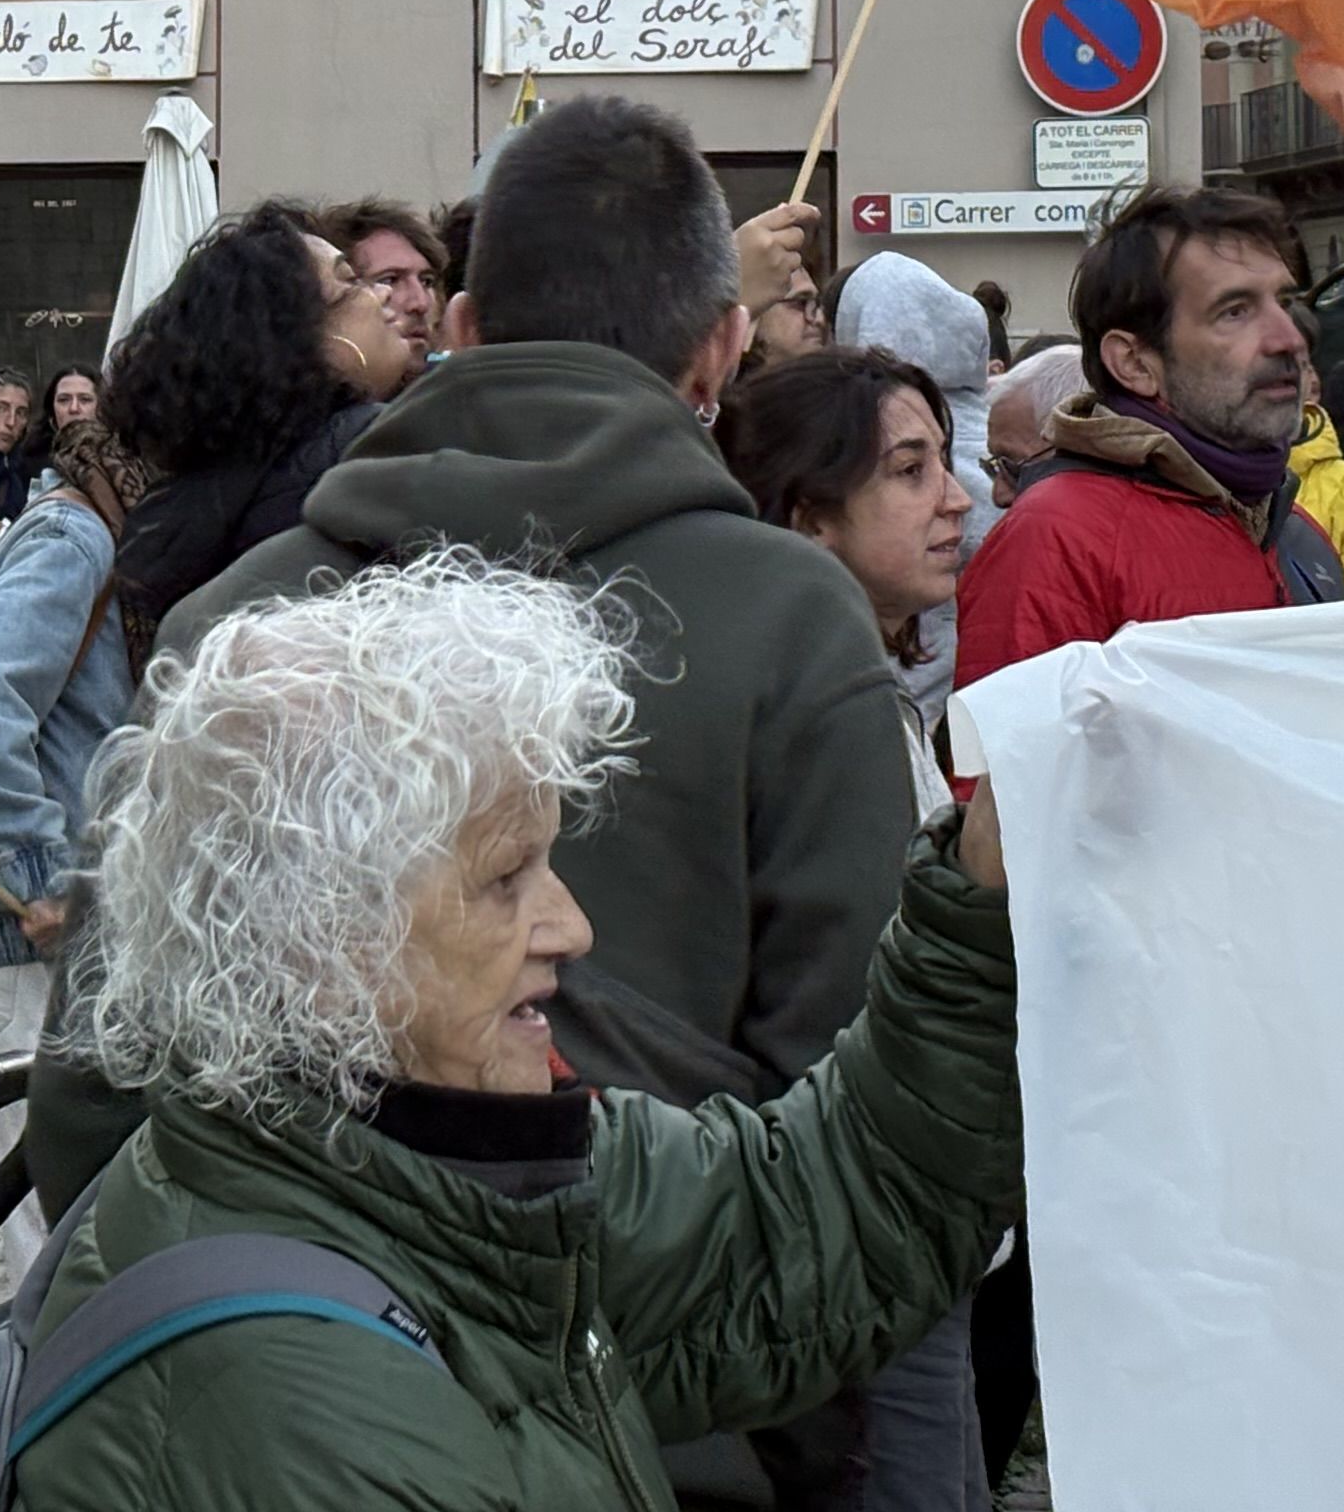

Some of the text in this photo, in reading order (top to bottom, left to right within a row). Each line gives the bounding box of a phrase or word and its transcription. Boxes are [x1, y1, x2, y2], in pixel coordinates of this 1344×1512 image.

[48, 11, 86, 53] de
[97, 10, 142, 55] te
[550, 25, 617, 61] del
[1039, 124, 1144, 138] A TOT EL CARRER
[934, 199, 1015, 224] Carrer
